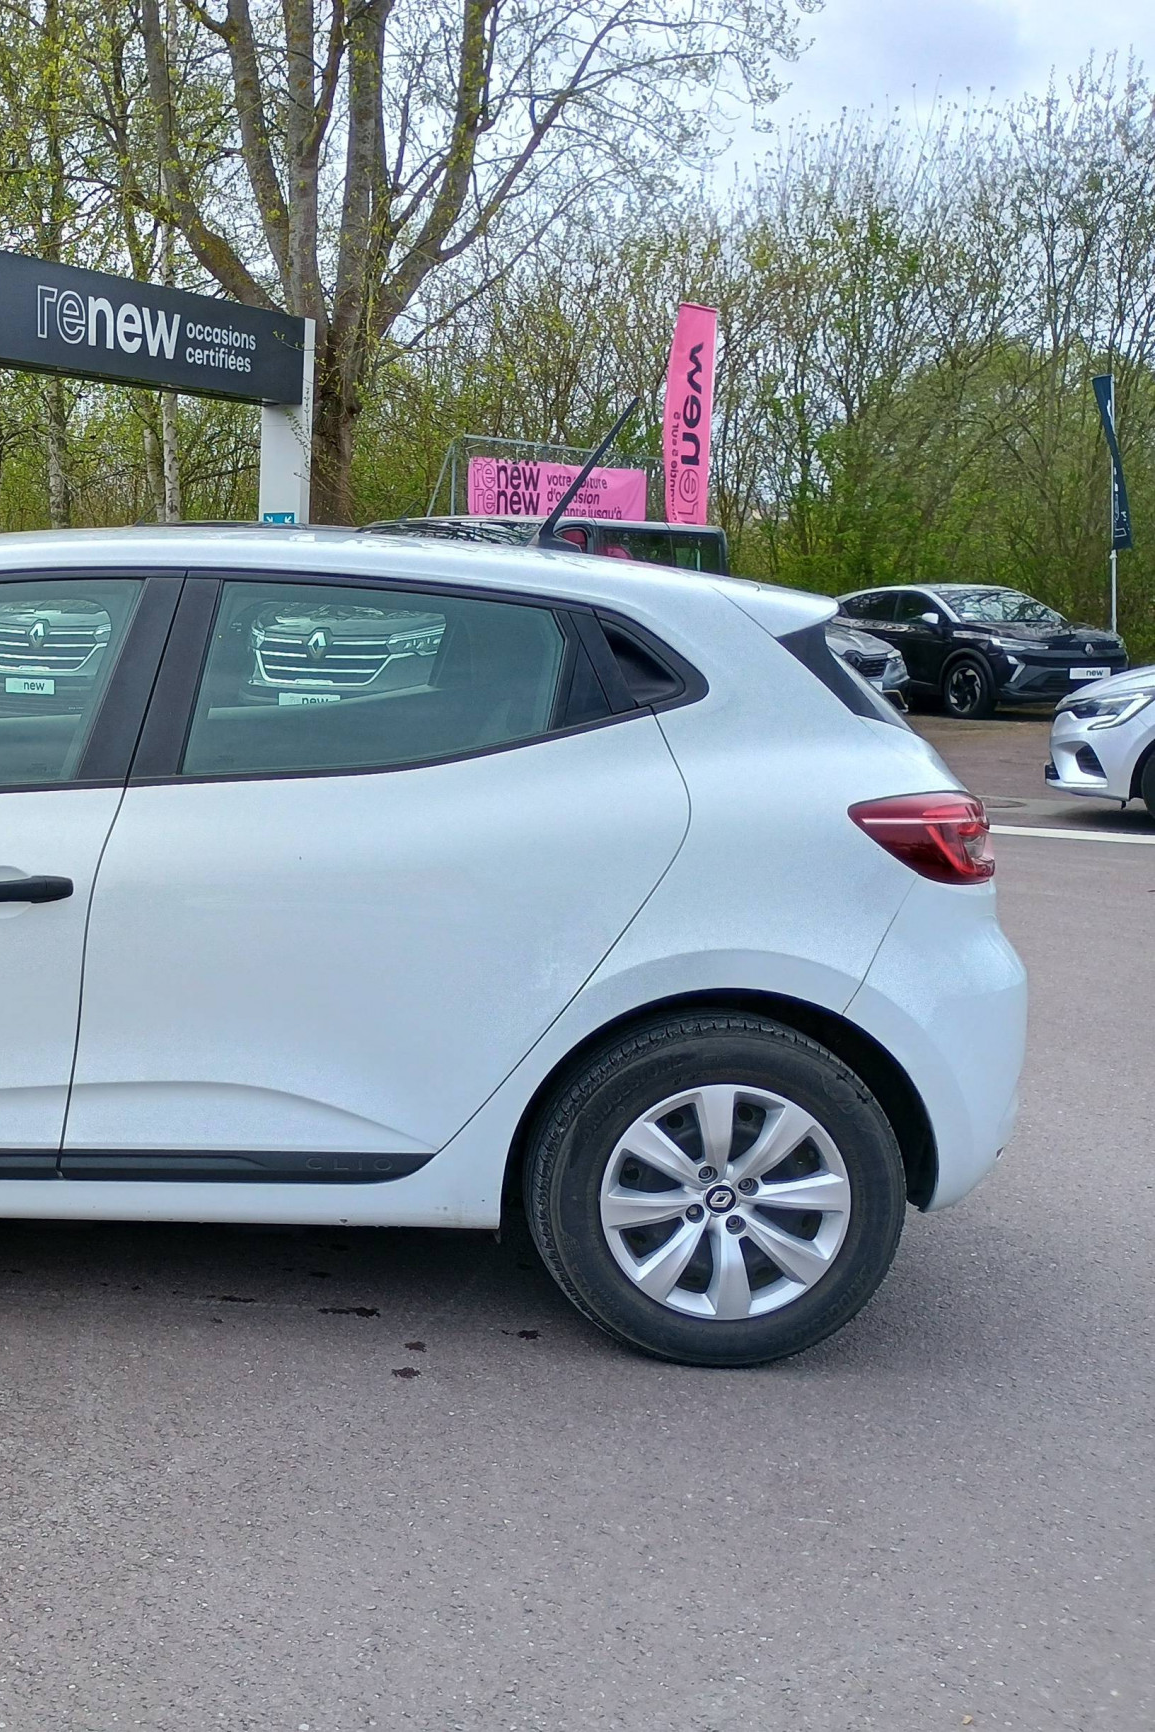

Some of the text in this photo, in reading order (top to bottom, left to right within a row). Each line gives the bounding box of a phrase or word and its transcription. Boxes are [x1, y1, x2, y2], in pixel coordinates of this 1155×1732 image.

[37, 284, 181, 360] renew
[186, 321, 257, 351] occasions
[185, 346, 252, 373] certifiées
[473, 463, 540, 491] renew
[546, 474, 608, 489] votre oiture
[474, 488, 540, 515] renew
[547, 487, 600, 505] d'osion
[23, 681, 45, 691] new
[305, 1157, 393, 1171] CLIO
